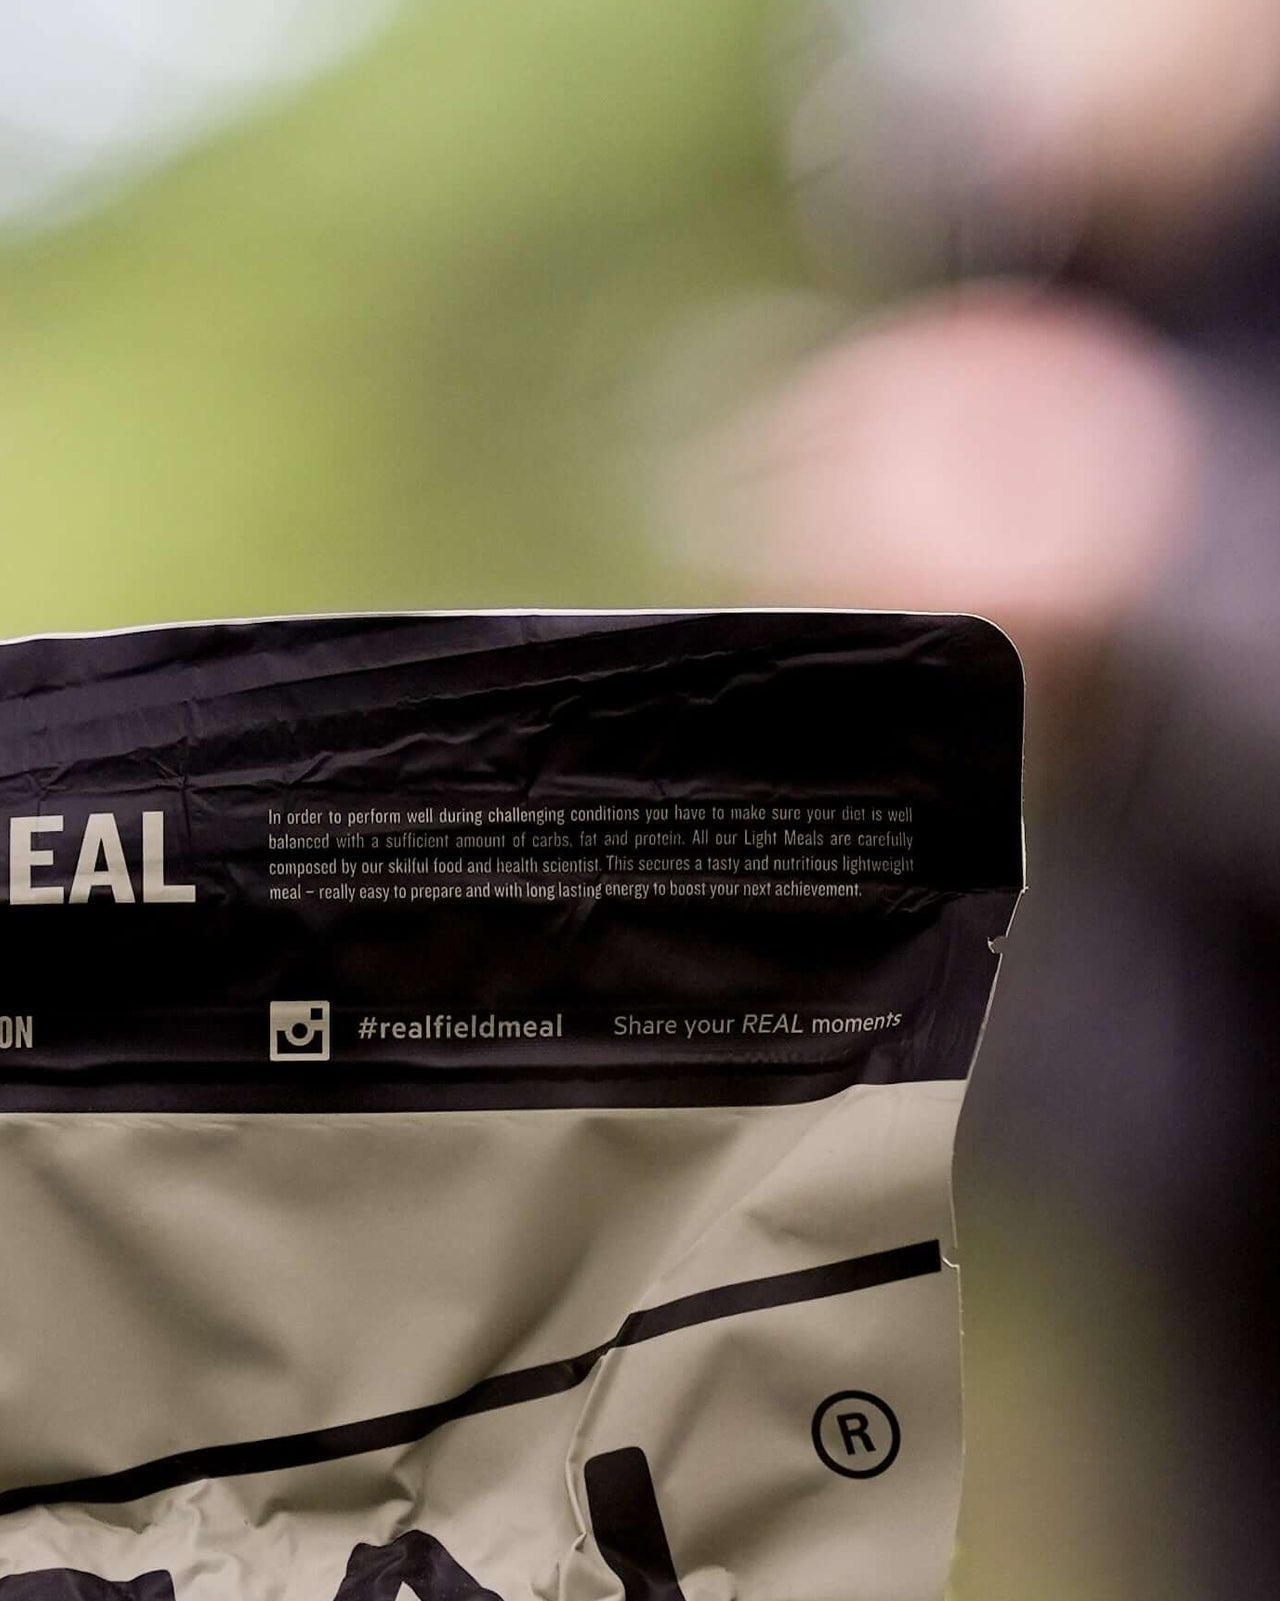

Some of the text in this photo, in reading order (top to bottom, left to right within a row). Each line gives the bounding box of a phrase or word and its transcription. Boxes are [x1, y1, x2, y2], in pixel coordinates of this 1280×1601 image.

[268, 803, 913, 830] In order to perform well during challenging conditions you have to make sure your diet is well
[268, 828, 913, 851] balanced with a sufficient amount of carbs, fat and protein. All our Light Meals are carefully
[268, 854, 914, 879] composed by our skilful food and health scientist. This secures a tasty and nutritious lightweight
[269, 883, 302, 900] meal
[319, 882, 356, 903] really
[359, 886, 390, 903] easy
[393, 884, 407, 899] to
[410, 886, 463, 902] prepare
[465, 881, 491, 898] and
[493, 881, 523, 899] with
[525, 881, 556, 901] long
[558, 881, 603, 900] lasting
[603, 882, 650, 900] energy
[652, 882, 666, 896] to
[669, 879, 706, 896] boost
[709, 883, 740, 900] your
[743, 881, 772, 897] next
[774, 879, 862, 897] achievement.
[358, 1013, 563, 1040] #realfieldmeal
[613, 1010, 903, 1040] Share your REAL moments
